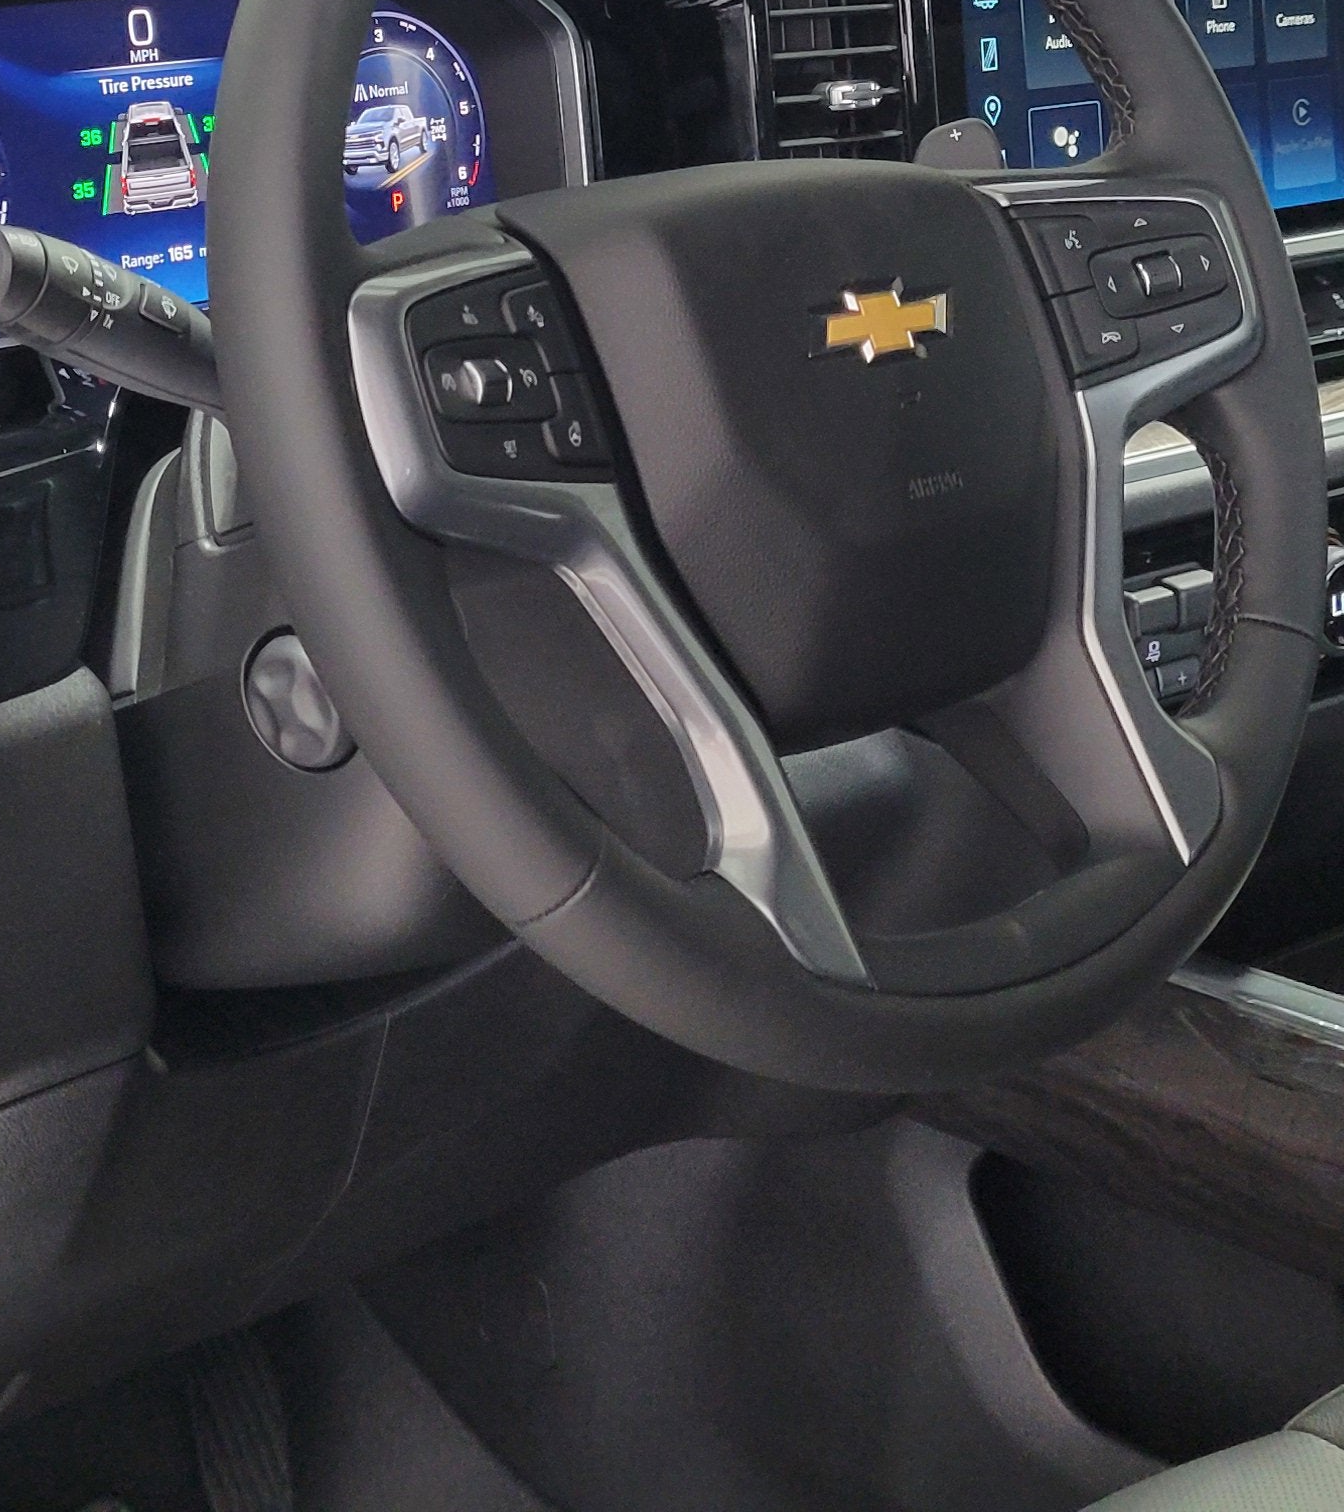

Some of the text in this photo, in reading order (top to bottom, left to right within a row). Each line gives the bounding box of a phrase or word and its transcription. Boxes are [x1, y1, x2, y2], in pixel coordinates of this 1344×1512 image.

[127, 8, 154, 47] 0
[1206, 19, 1236, 34] Phone
[1275, 12, 1316, 28] Cameras
[373, 28, 384, 43] 3
[129, 48, 160, 64] MPH
[425, 47, 436, 62] 4
[99, 73, 194, 95] Tire Pressure
[369, 81, 409, 99] Normal
[459, 101, 469, 116] 5
[80, 128, 103, 146] 36
[457, 166, 468, 181] 6
[72, 180, 96, 200] 35
[450, 186, 469, 198] RPM
[391, 190, 405, 214] P
[121, 252, 165, 270] Range:
[167, 245, 193, 263] 165
[105, 291, 121, 306] OFF
